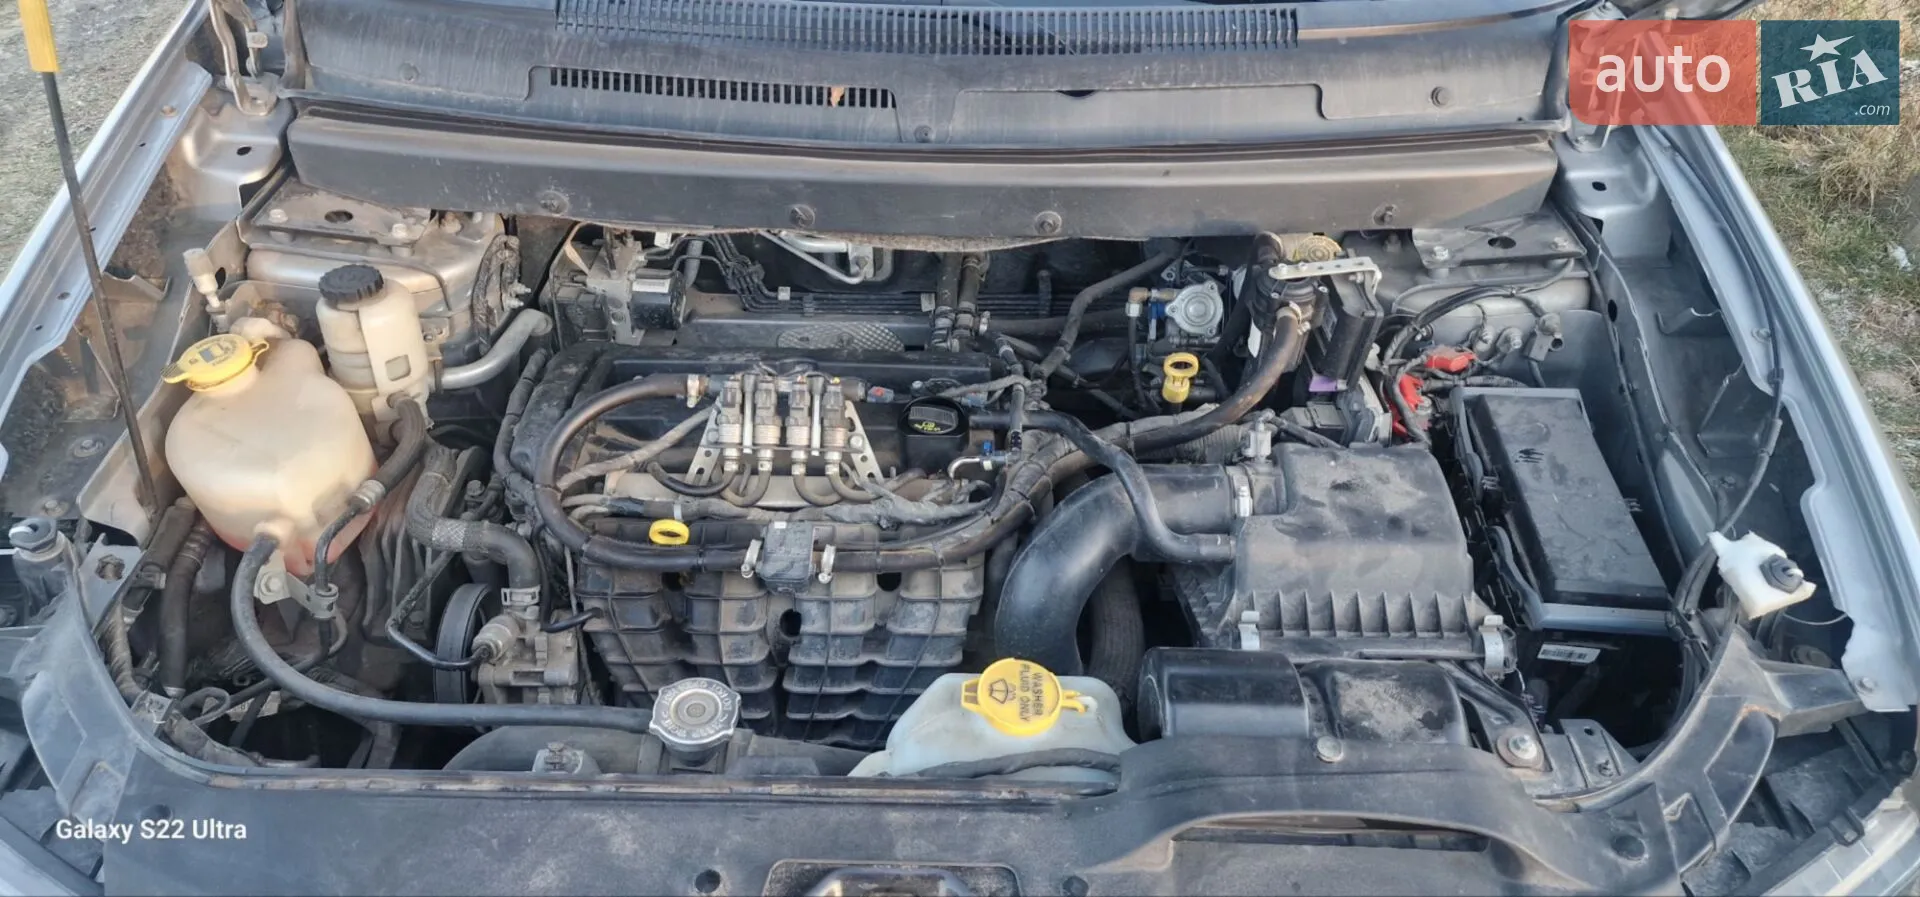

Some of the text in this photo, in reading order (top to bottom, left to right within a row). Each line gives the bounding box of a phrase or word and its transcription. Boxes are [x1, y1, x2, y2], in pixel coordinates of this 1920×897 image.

[1019, 663, 1031, 722] FLUID ONLY
[1031, 672, 1044, 716] WASHER
